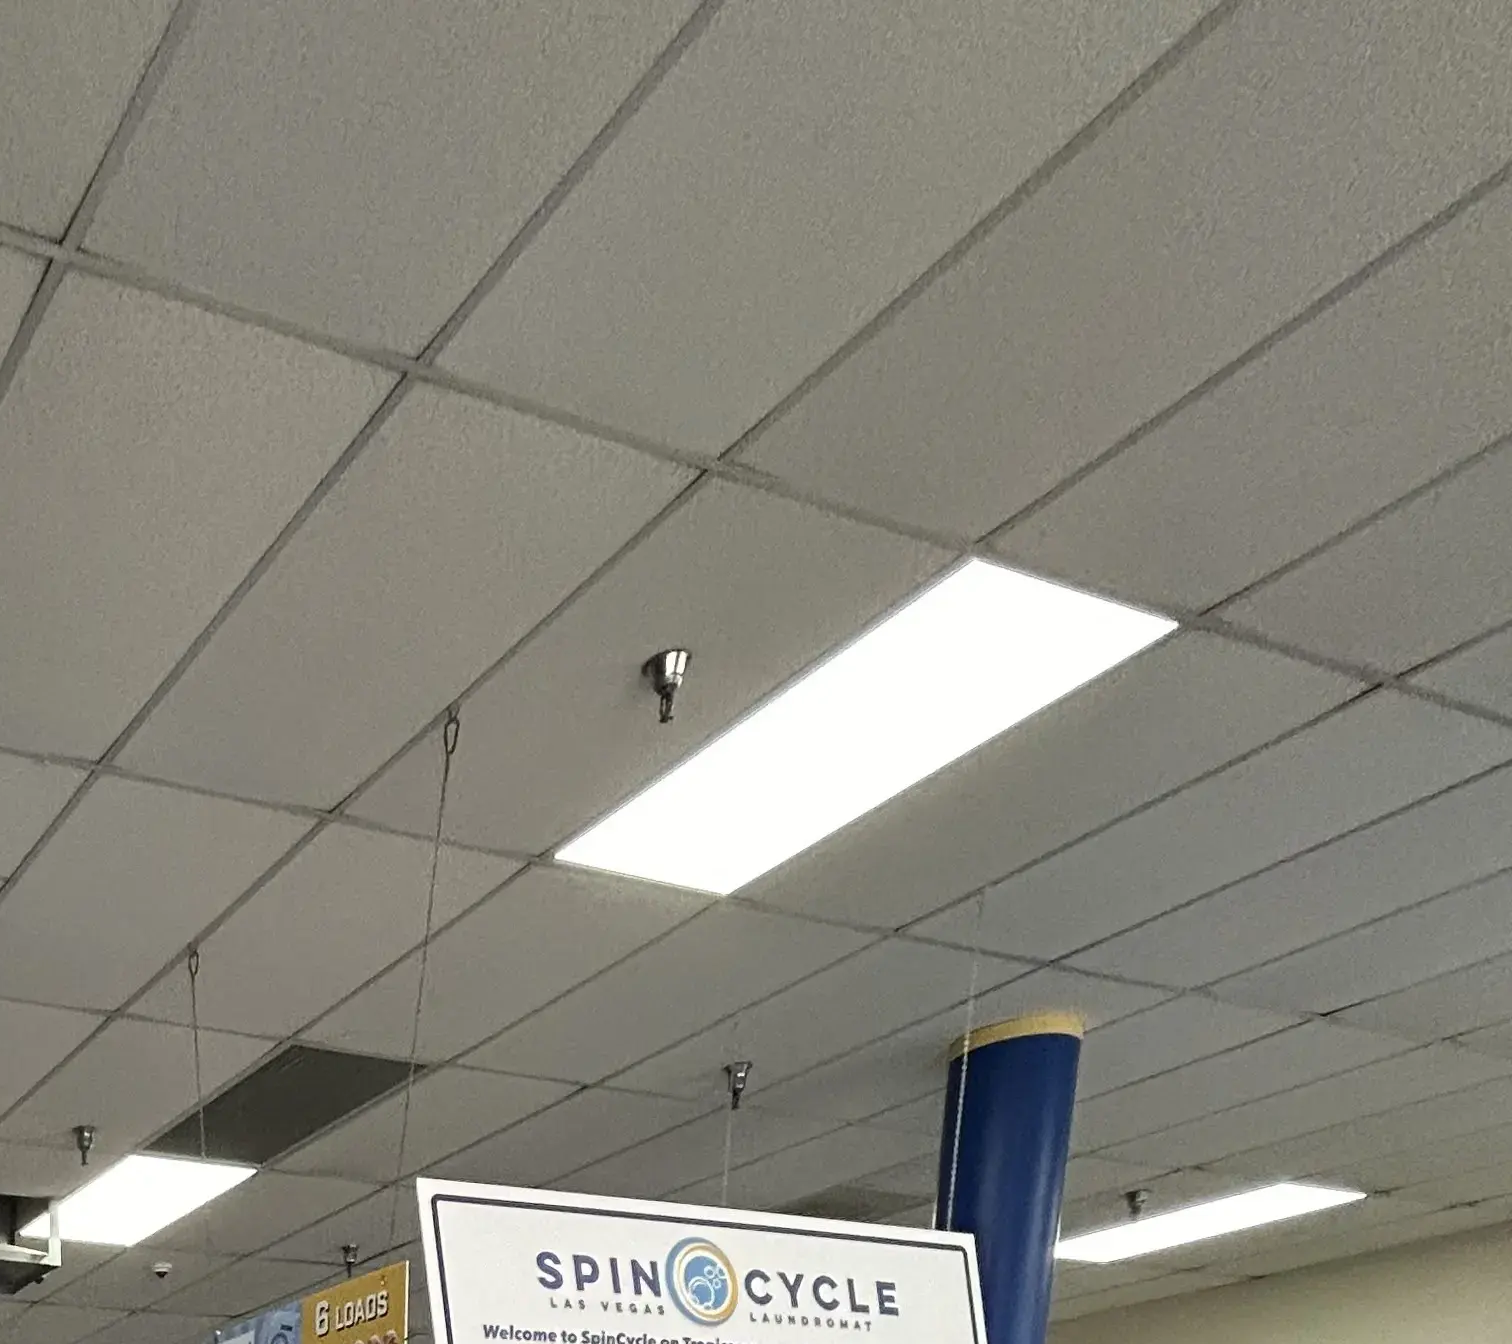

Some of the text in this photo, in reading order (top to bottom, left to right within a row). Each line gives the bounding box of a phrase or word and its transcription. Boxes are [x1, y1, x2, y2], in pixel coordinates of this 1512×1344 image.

[536, 1251, 899, 1316] SPIN CYCLE
[314, 1290, 389, 1338] 6 LOADS
[550, 1297, 665, 1315] LAS VEGAS
[749, 1311, 872, 1332] LAUNDROMAT
[483, 1324, 557, 1343] Welcome
[561, 1330, 577, 1344] to
